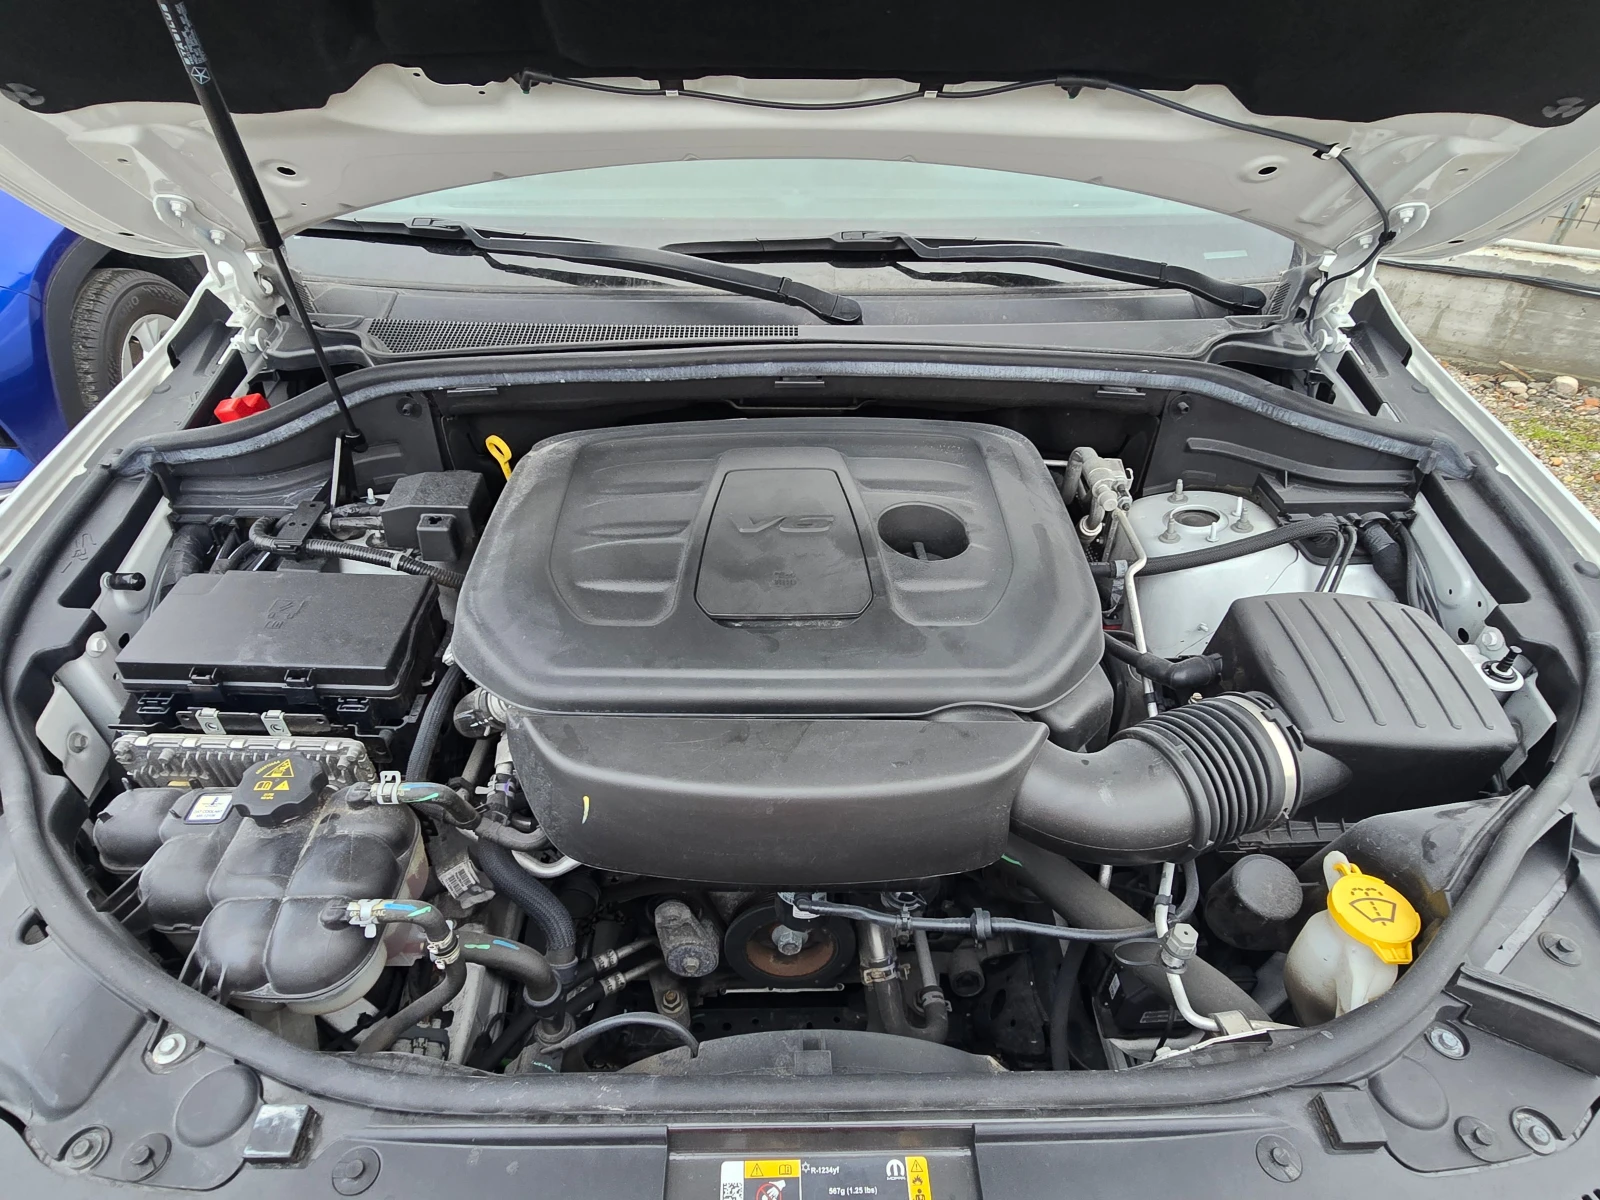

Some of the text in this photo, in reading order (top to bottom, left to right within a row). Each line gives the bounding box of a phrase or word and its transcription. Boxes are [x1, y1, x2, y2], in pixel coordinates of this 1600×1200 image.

[728, 513, 835, 533] V6
[810, 1166, 840, 1175] R-1234yf
[846, 1186, 863, 1196] (1.25
[863, 1186, 878, 1195] lbs)
